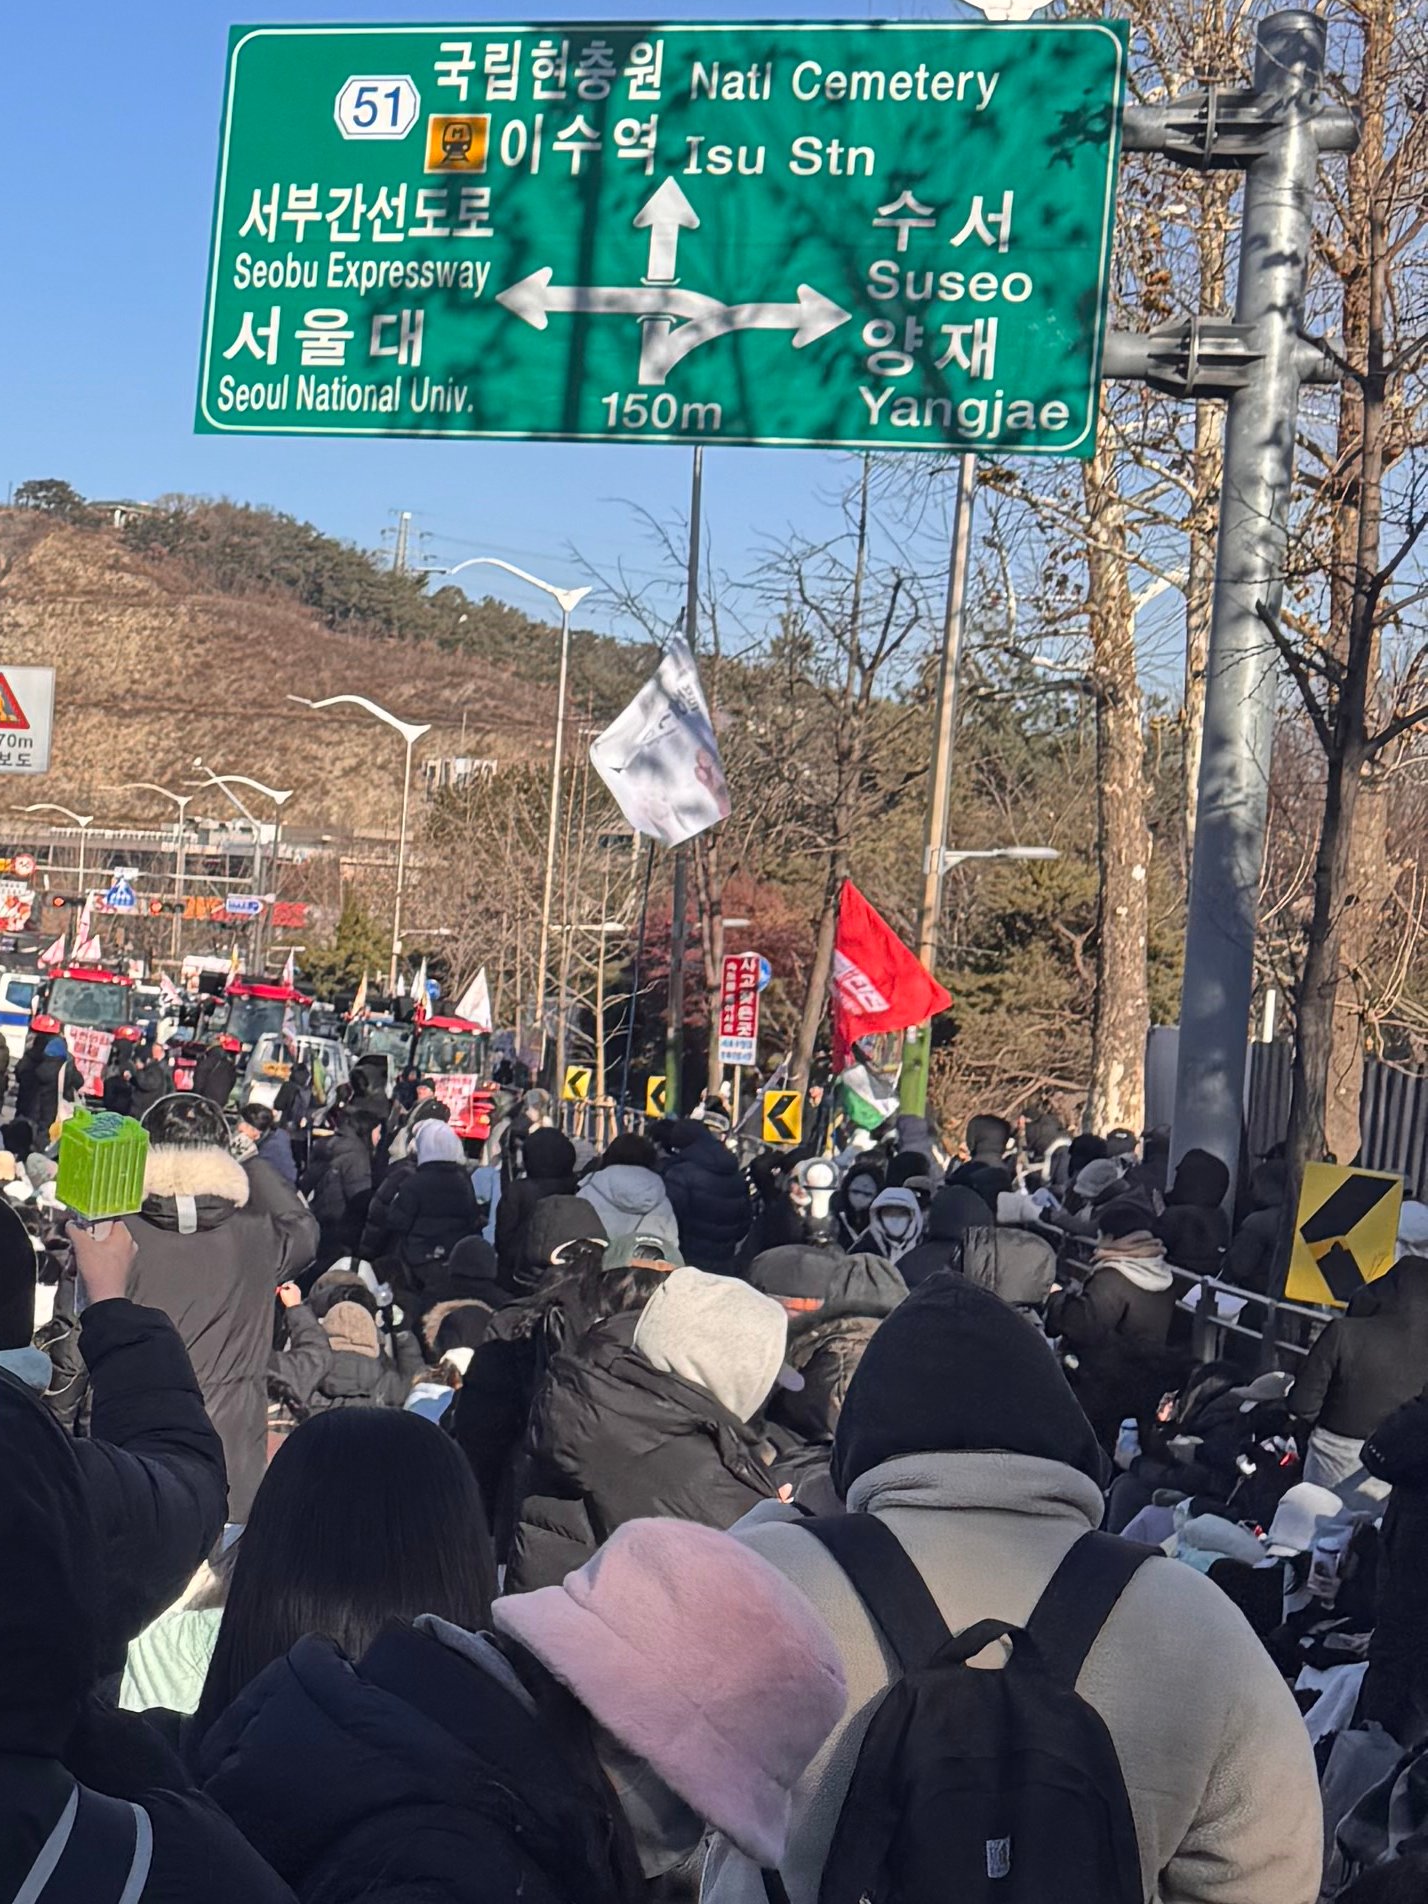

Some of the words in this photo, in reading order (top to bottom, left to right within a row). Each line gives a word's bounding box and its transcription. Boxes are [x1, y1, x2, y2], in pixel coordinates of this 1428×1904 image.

[434, 40, 664, 101] 국립현충원
[690, 61, 772, 100] Natl
[792, 61, 1000, 111] Cemetery
[352, 86, 402, 127] 51
[500, 114, 659, 176] 이수역
[682, 136, 766, 176] Isu
[788, 137, 875, 176] Stn
[239, 183, 494, 243] 서부간선도로
[872, 190, 1014, 253] 수서
[233, 252, 319, 290] Seobu
[327, 258, 490, 298] Expressway
[867, 261, 1033, 302] Suseo
[223, 306, 425, 367] 서울대
[861, 316, 999, 380] 양재
[217, 375, 288, 413] Seoul
[297, 377, 400, 413] National
[410, 378, 474, 414] Univ.
[601, 394, 723, 430] 150m
[858, 386, 1070, 439] Yangjae
